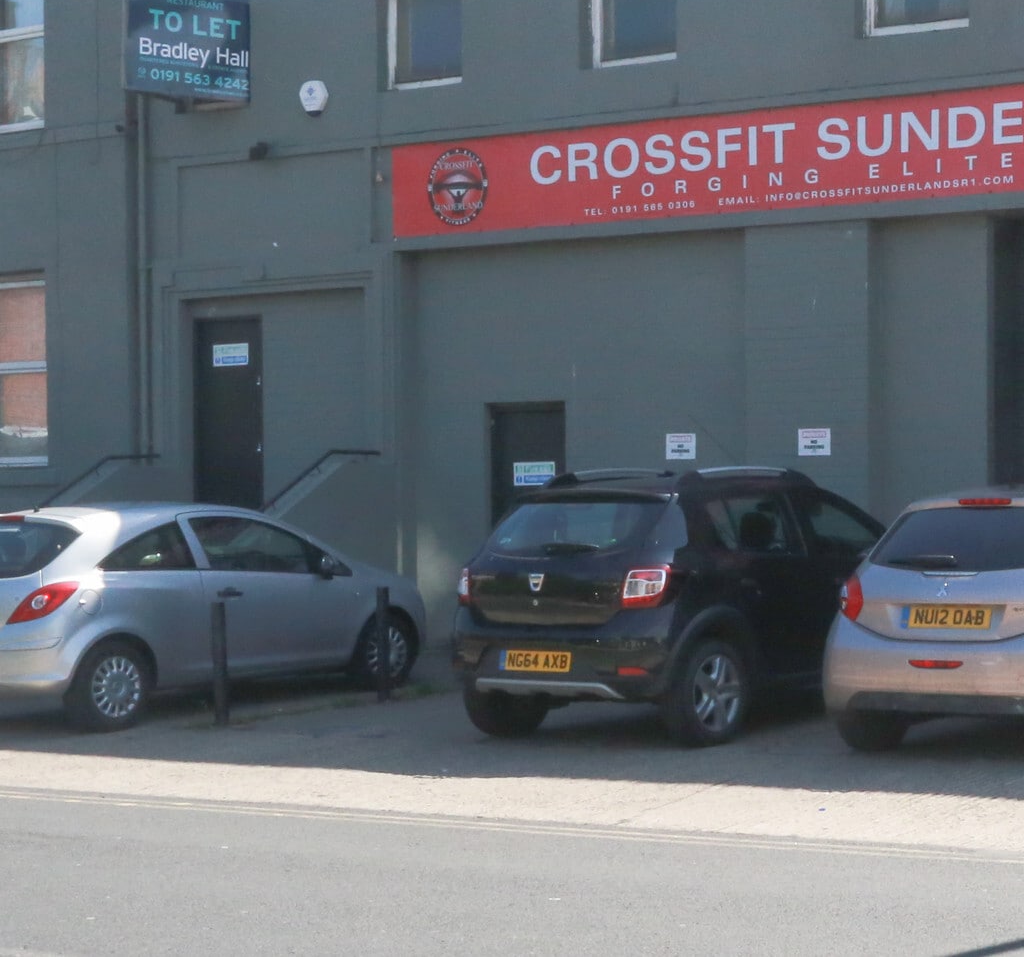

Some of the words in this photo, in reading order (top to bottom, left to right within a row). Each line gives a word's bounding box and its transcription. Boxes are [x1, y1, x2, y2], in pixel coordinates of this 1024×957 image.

[148, 8, 183, 33] TO
[192, 14, 242, 40] LET
[139, 37, 211, 68] Bradley
[216, 47, 249, 68] Hall
[150, 68, 180, 82] 0191
[184, 72, 210, 86] 563
[214, 76, 249, 91] 4242
[529, 122, 796, 185] CROSSFIT
[612, 169, 818, 199] FORGING
[868, 152, 1013, 179] ELITE
[612, 205, 637, 214] 0191
[718, 196, 760, 205] EMAIL:
[765, 175, 1014, 202] INFO@CROSSFITSUNDERLANDSR1.COM
[914, 609, 950, 625] NU12
[507, 652, 540, 668] NG64
[543, 653, 568, 669] AXB
